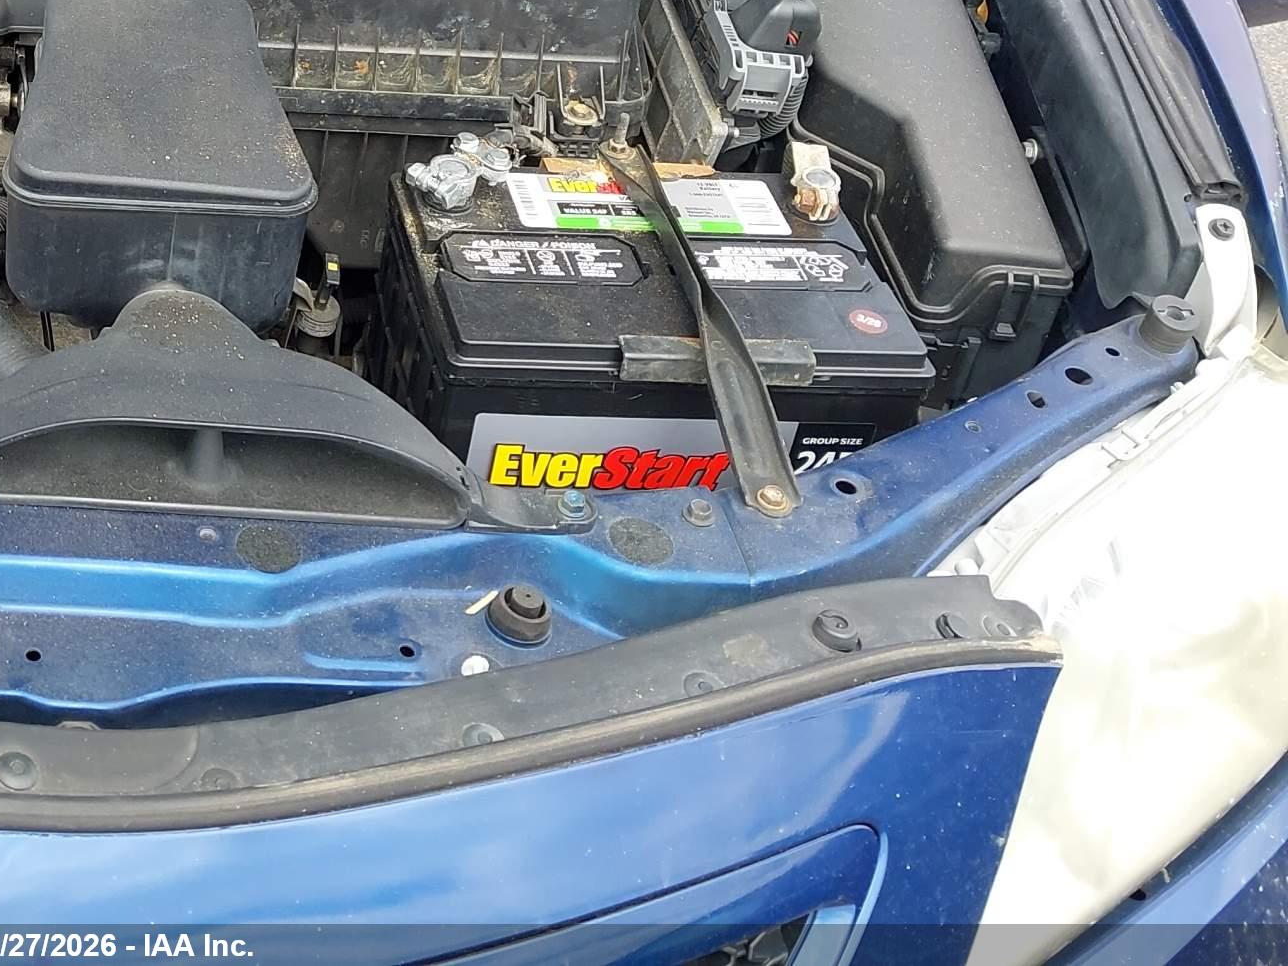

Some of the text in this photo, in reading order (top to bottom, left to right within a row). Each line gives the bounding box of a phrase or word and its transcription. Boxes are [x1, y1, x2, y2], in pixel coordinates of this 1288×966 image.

[490, 239, 539, 249] DANGER
[550, 242, 597, 250] POISON
[802, 437, 839, 445] GROUP
[489, 443, 730, 490] EverStart
